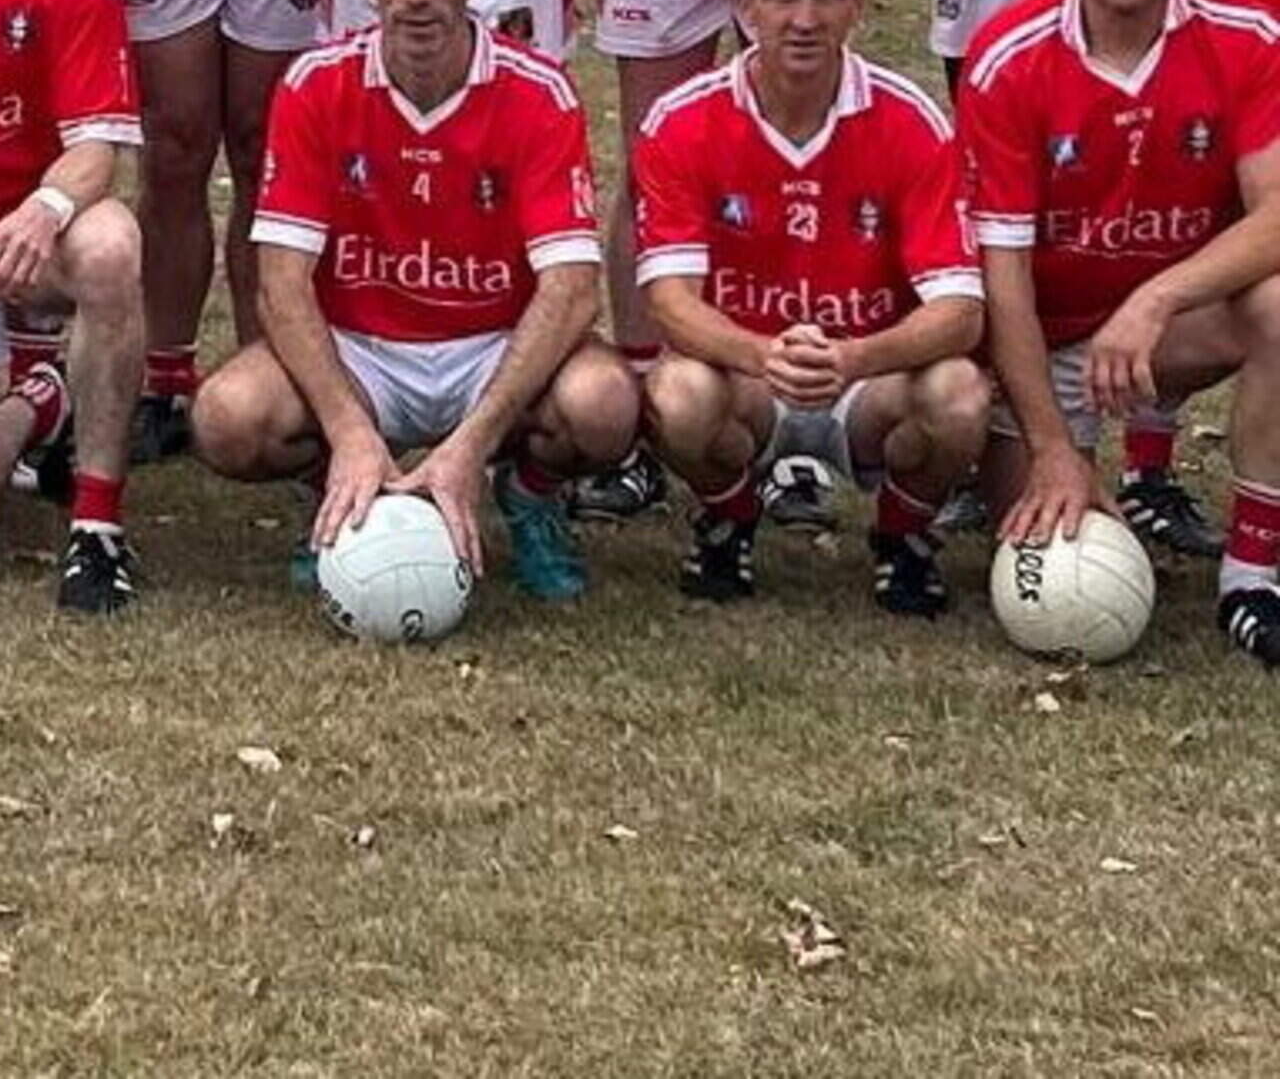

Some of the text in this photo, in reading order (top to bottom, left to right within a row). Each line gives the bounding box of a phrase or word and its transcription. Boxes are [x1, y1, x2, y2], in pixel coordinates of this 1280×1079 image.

[411, 171, 431, 204] 4
[786, 202, 819, 242] 23
[334, 232, 514, 292] Eirdata
[714, 267, 894, 326] Eirdata
